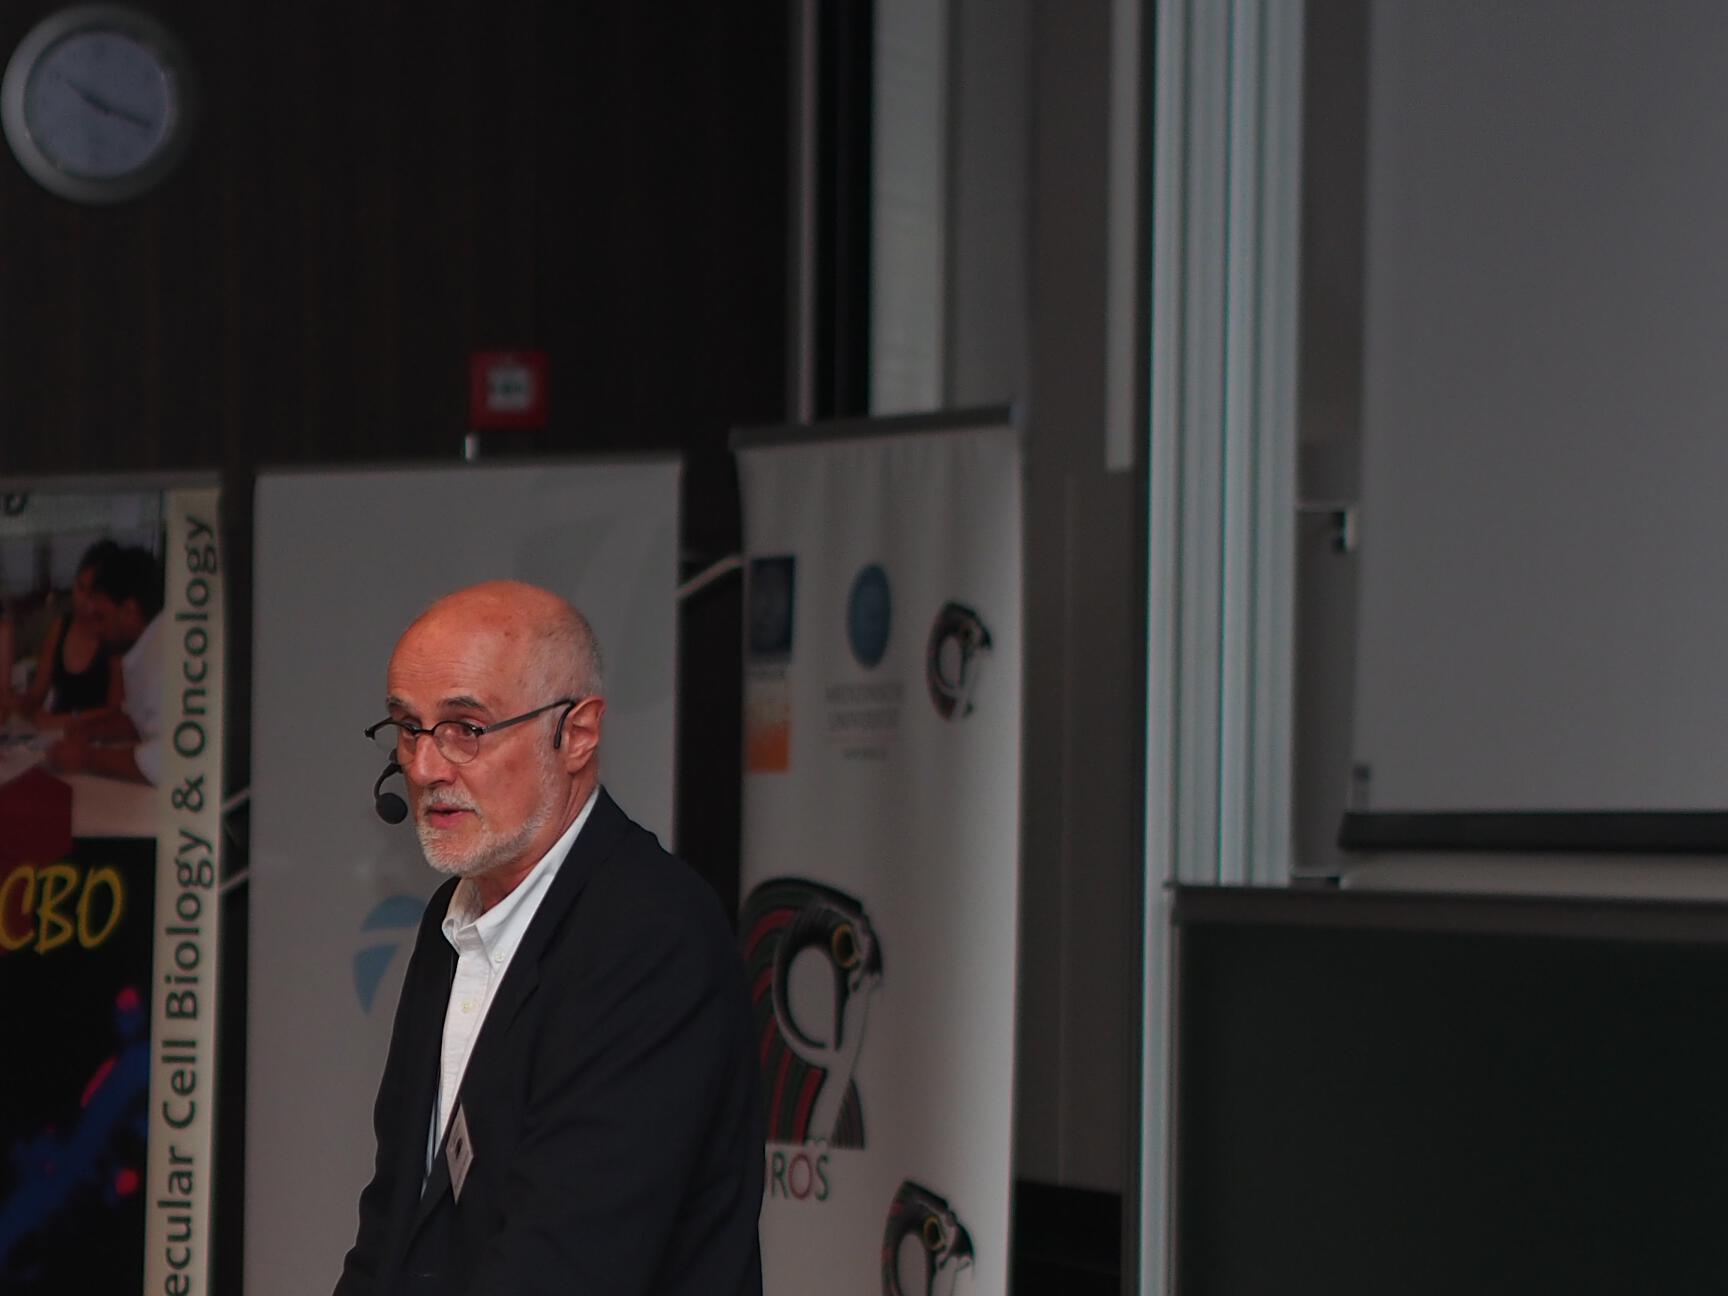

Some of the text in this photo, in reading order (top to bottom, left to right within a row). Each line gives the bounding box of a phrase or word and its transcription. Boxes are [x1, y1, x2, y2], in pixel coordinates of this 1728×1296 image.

[174, 516, 217, 758] Oncology
[173, 773, 205, 812] &
[165, 829, 214, 1020] Biology
[161, 1039, 197, 1129] Cell
